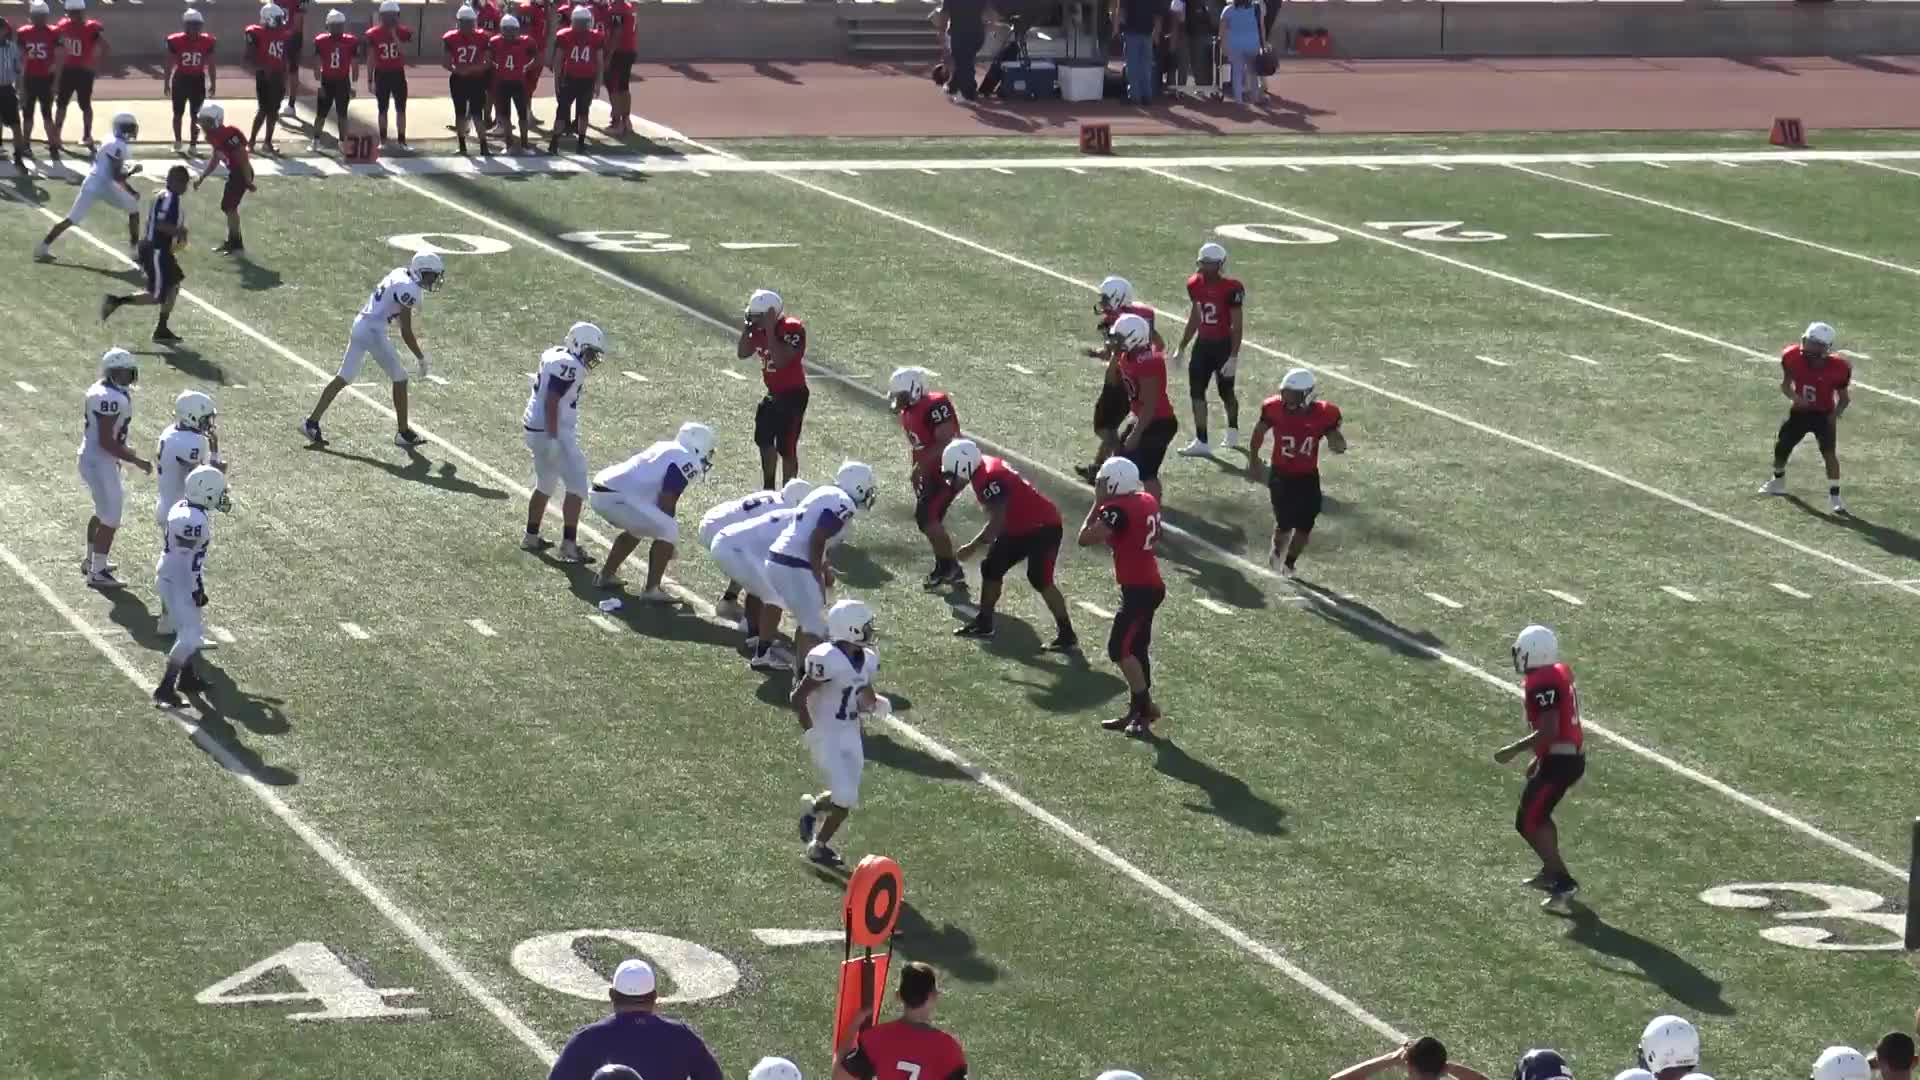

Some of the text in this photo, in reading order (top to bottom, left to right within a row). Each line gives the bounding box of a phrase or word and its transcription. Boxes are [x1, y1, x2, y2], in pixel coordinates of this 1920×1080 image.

[457, 45, 477, 63] 27
[505, 55, 514, 71] 4
[570, 46, 590, 63] 44
[1085, 127, 1109, 149] 20
[344, 135, 371, 160] 30
[560, 364, 577, 379] 75
[1802, 384, 1817, 402] 6
[100, 400, 119, 413] 80
[931, 404, 951, 423] 92
[1281, 435, 1314, 458] 24
[680, 461, 697, 480] 66
[1535, 689, 1556, 707] 37
[865, 872, 897, 935] 0
[896, 1060, 921, 1080] 7
